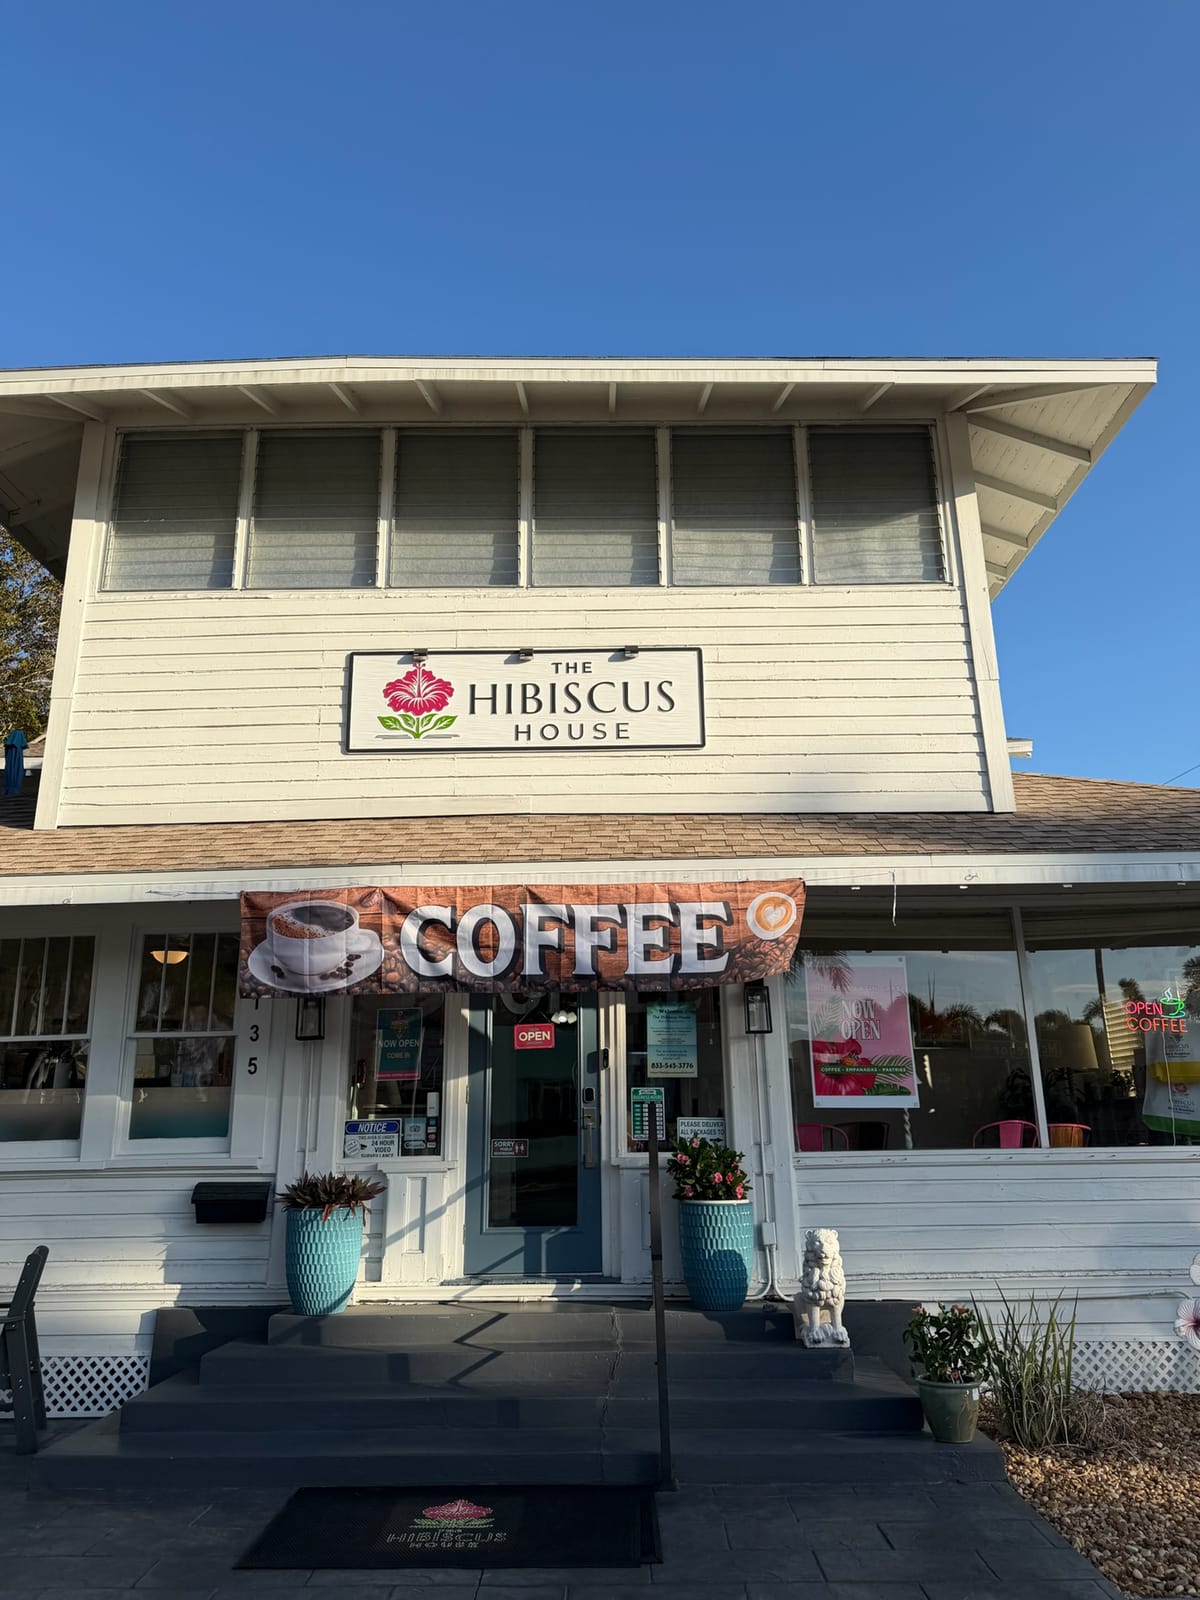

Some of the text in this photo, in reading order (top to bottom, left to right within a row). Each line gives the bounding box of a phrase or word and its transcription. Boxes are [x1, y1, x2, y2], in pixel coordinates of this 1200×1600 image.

[550, 661, 593, 674] THE
[468, 680, 676, 715] HIBISCUS
[513, 722, 631, 741] HOUSE
[400, 901, 735, 978] COFFEE
[841, 999, 875, 1019] NOW
[1124, 1001, 1163, 1016] OPEN
[840, 1020, 881, 1041] OPEN
[1126, 1017, 1189, 1033] COFFEE
[378, 1039, 420, 1049] NOW OPEN
[518, 1031, 551, 1042] OPEN
[357, 1122, 387, 1133] NOTICE
